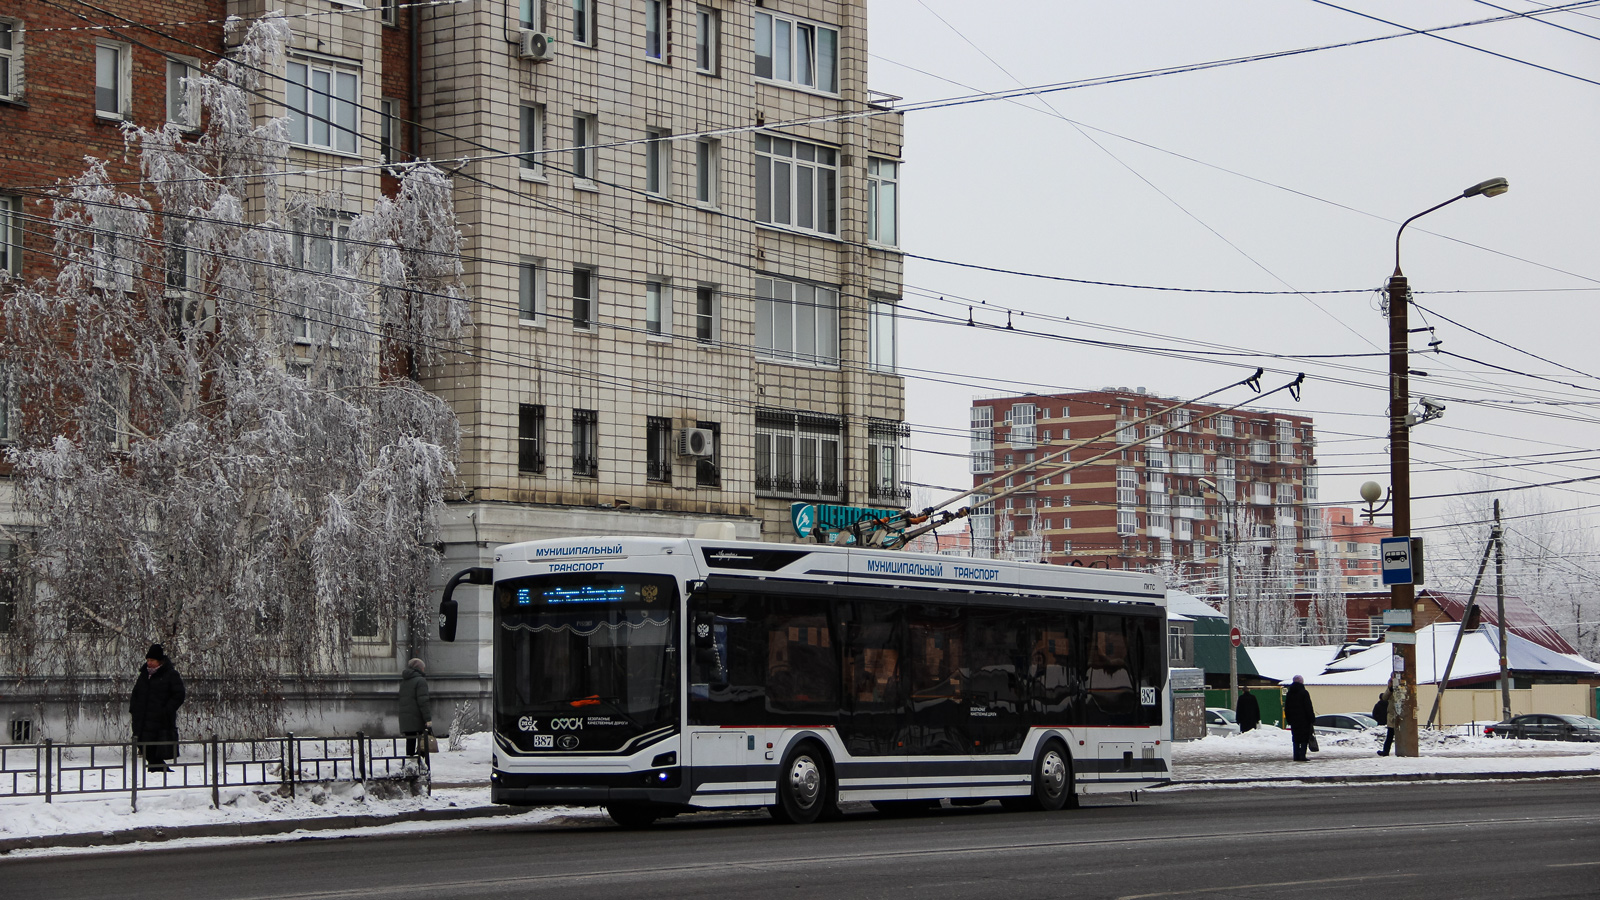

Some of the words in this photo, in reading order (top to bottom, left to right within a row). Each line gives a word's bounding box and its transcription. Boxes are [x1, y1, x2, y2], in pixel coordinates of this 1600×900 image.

[536, 544, 622, 556] МУНИЦИПАЛЬНЫЙ
[549, 562, 604, 572] ТРАНСПОРТ
[867, 560, 943, 577] МУНИЦИПАЛЬНЫЙ
[953, 566, 999, 581] ТРАНСПОРТ
[1141, 689, 1155, 703] 387
[535, 736, 552, 746] 387
